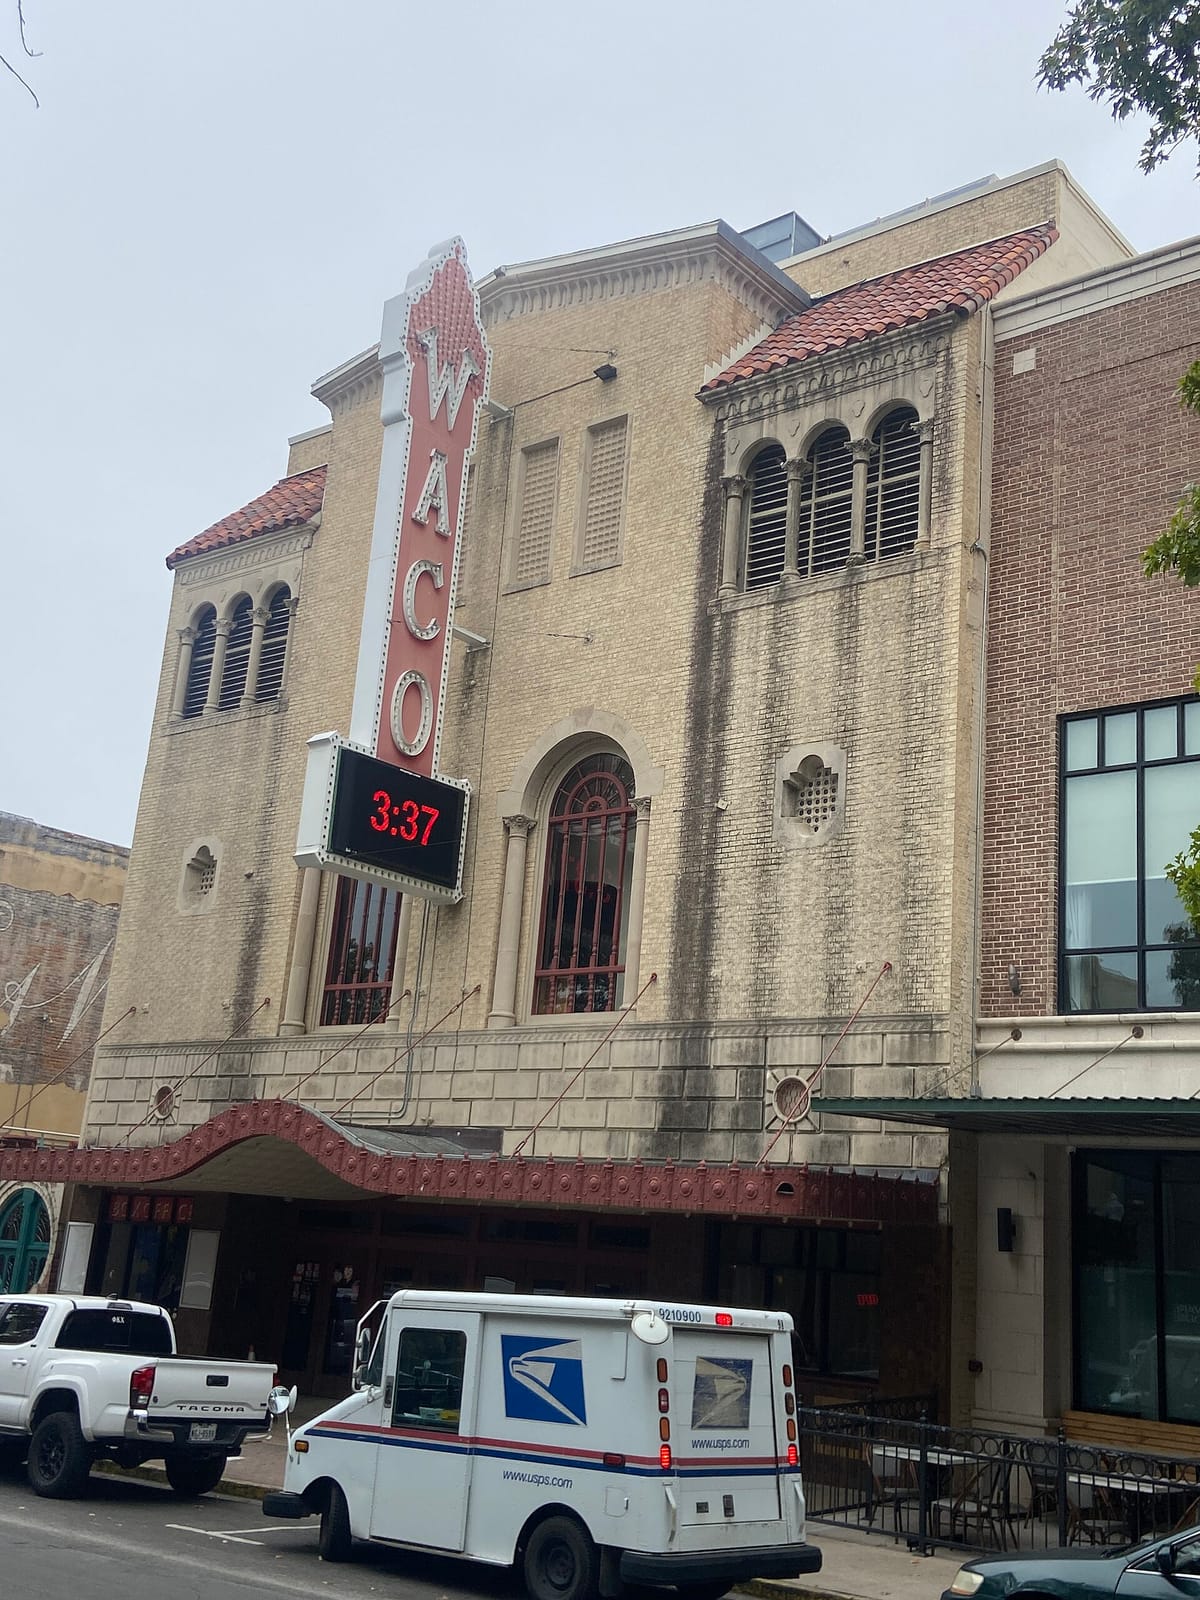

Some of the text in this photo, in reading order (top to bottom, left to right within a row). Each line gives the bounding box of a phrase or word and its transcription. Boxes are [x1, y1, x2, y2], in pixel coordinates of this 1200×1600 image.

[389, 326, 482, 757] WACO
[370, 790, 440, 846] 3:37
[659, 1308, 701, 1323] 9210900
[691, 1439, 750, 1452] www.usps.com
[502, 1470, 573, 1489] www.usps.com
